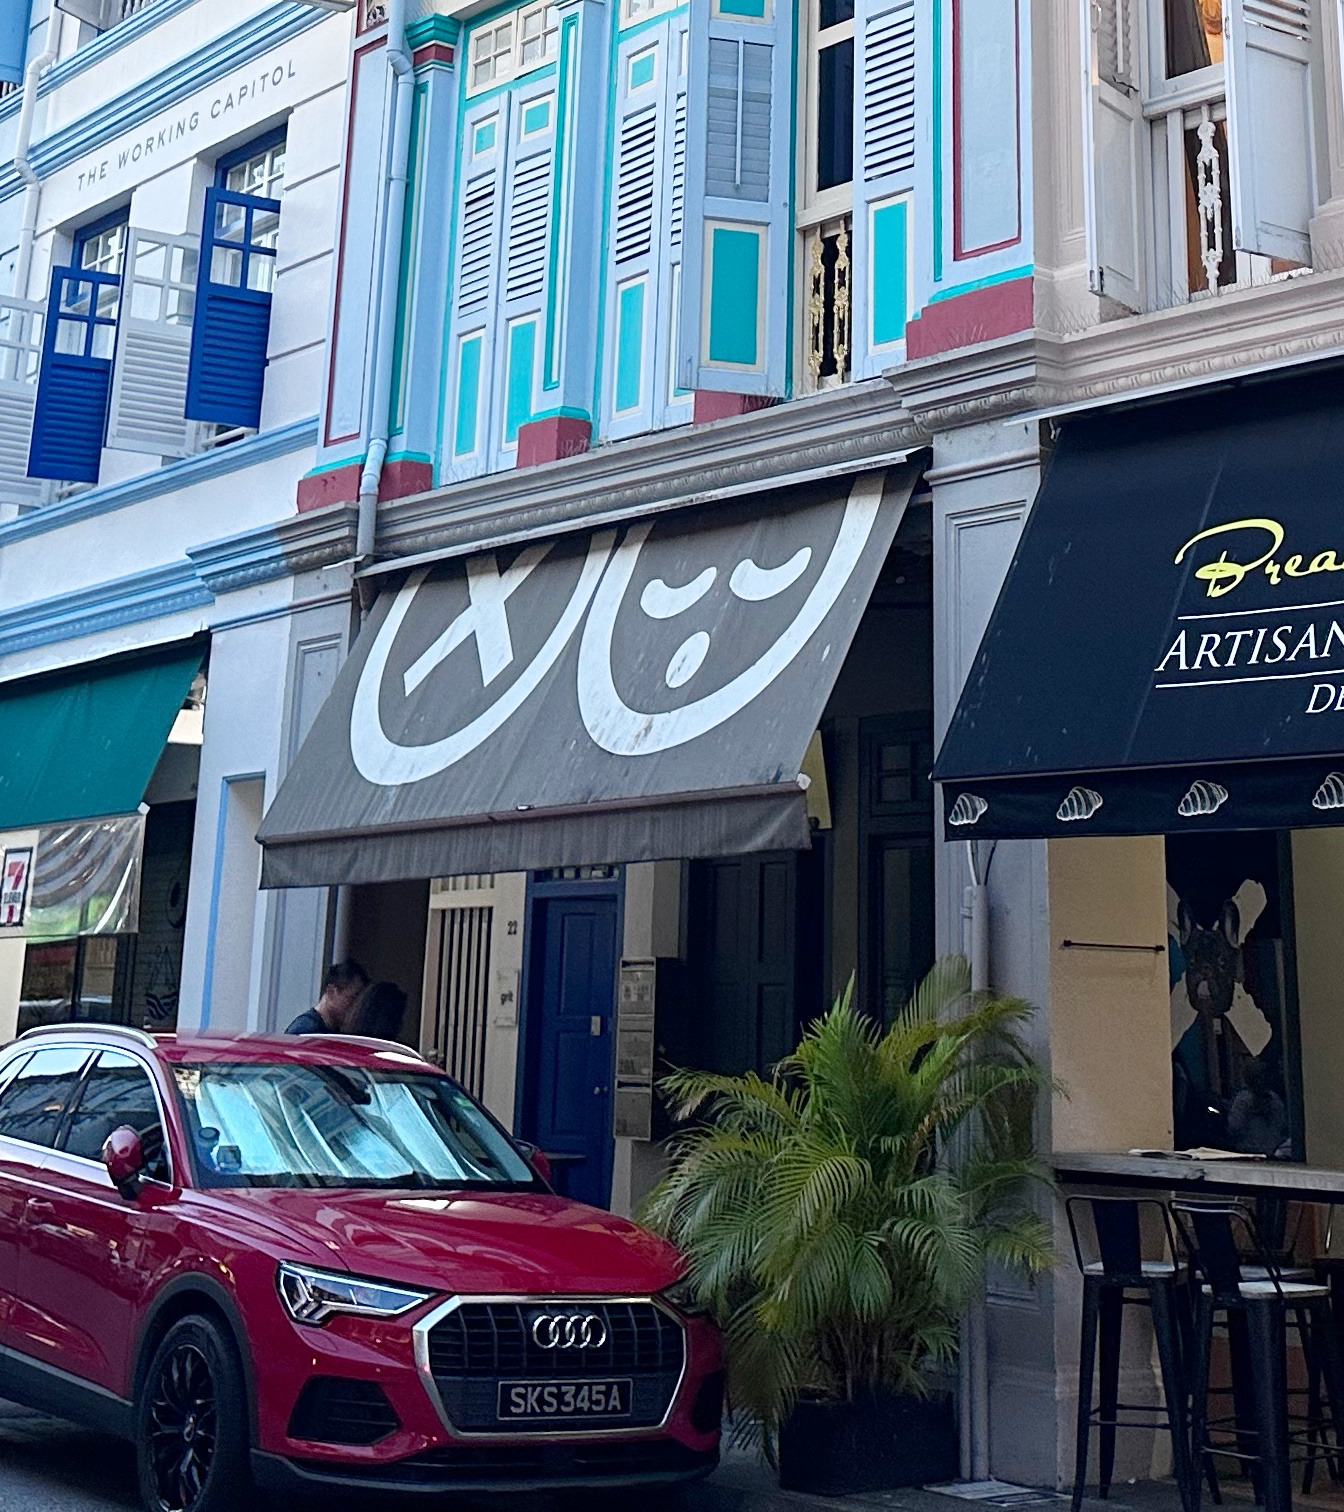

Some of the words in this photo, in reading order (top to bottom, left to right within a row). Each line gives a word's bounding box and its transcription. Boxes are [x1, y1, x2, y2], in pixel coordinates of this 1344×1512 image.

[77, 160, 109, 192] THE
[118, 111, 200, 170] WORKING
[210, 59, 296, 120] CAPITOL
[510, 1384, 622, 1414] SKS345A
